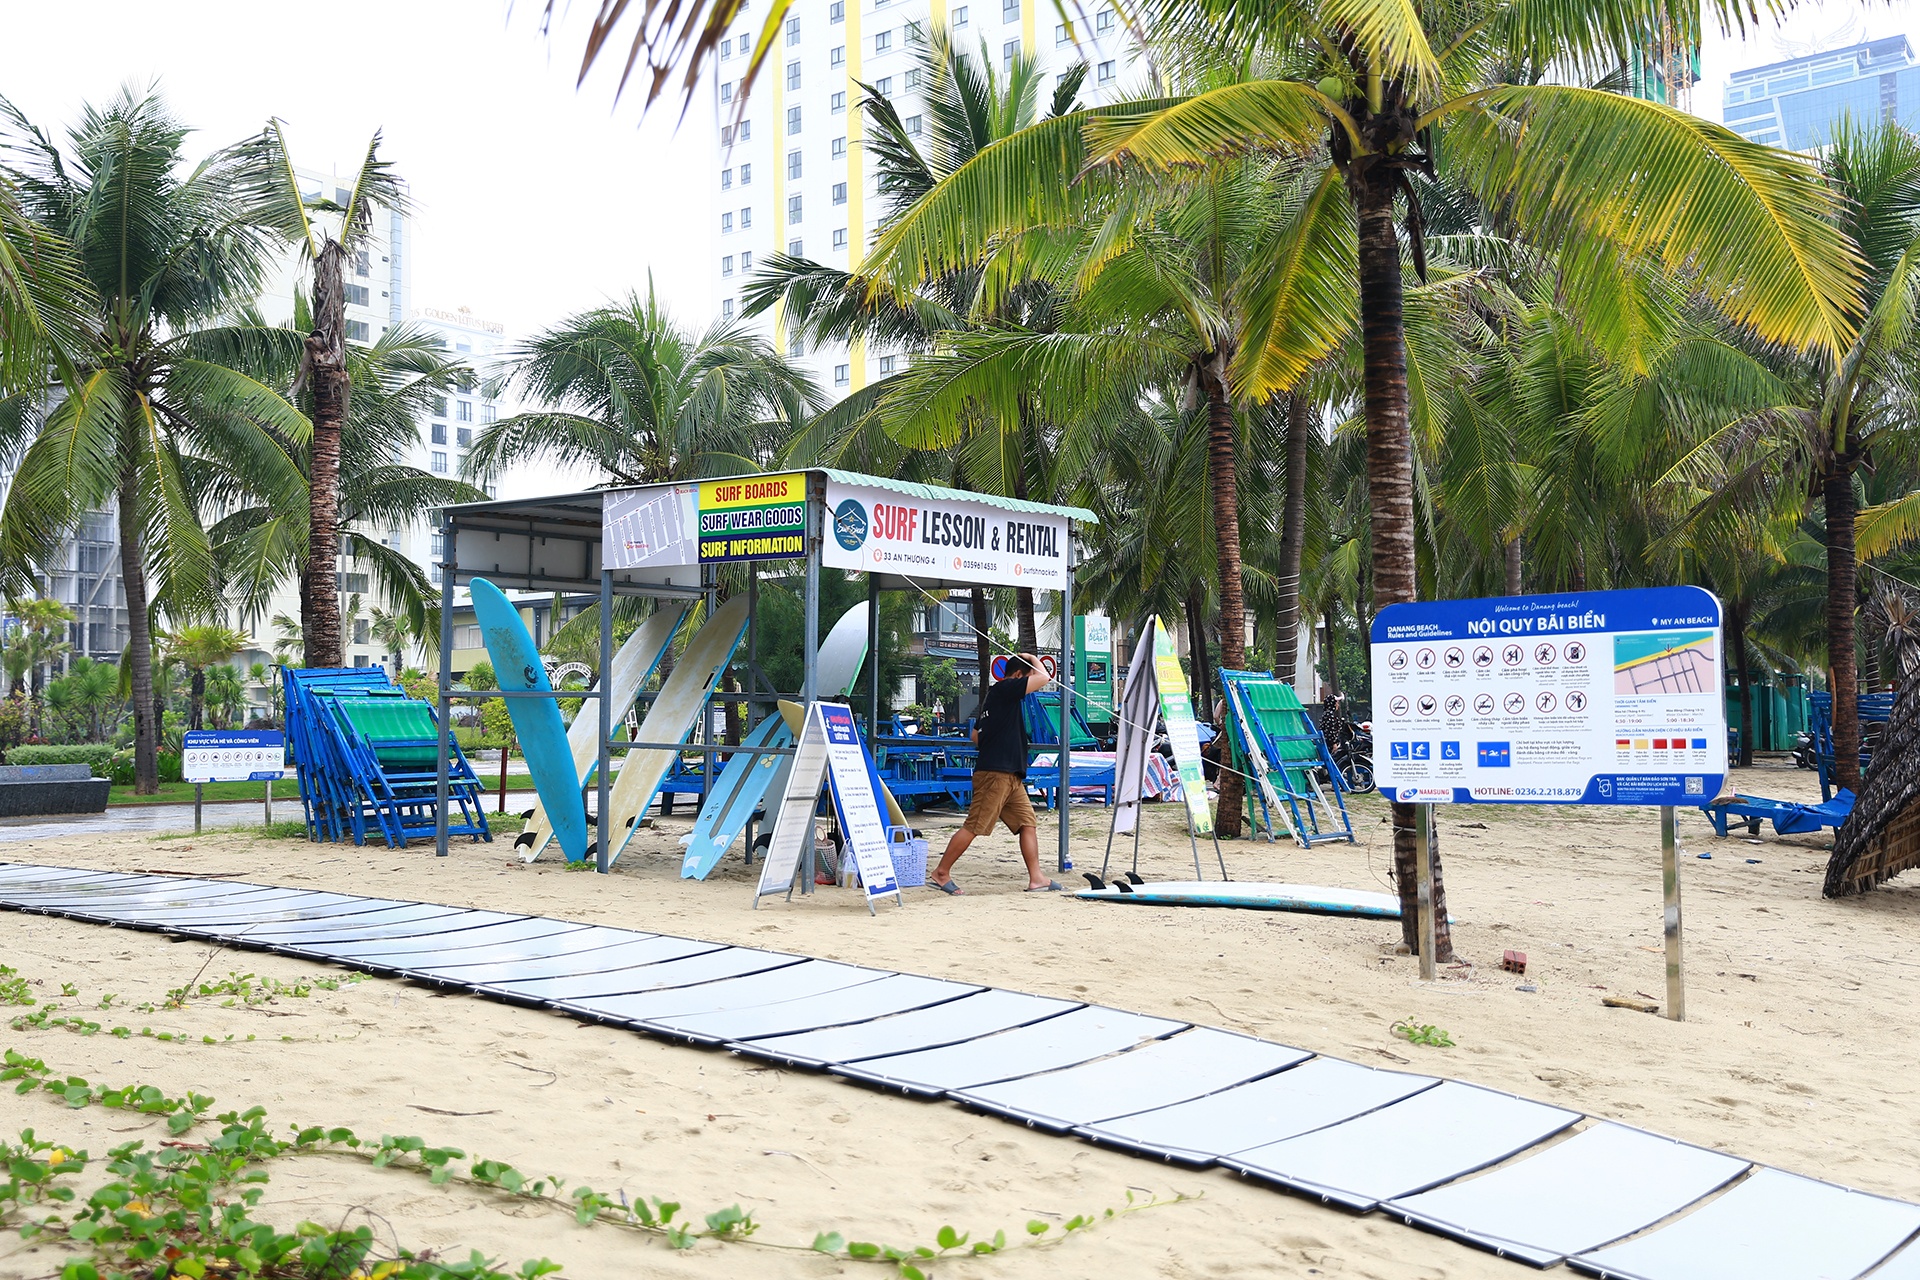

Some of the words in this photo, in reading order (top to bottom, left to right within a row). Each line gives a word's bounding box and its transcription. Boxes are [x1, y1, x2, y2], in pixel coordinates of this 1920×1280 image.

[716, 486, 742, 502] SURF
[745, 480, 788, 500] BOARDS
[702, 514, 728, 531] SURF
[731, 511, 762, 528] WEAR
[765, 507, 802, 526] GOODS
[872, 503, 918, 542] SURF
[922, 510, 985, 550] LESSON
[992, 526, 1000, 551] &
[1006, 521, 1059, 558] RENTAL
[701, 541, 727, 558] SURF
[730, 536, 803, 556] INFORMATION
[884, 552, 892, 561] 33
[893, 553, 902, 561] AN
[963, 560, 997, 571] 0359614535
[1495, 604, 1520, 613] Welcome
[1530, 602, 1555, 611] Danang
[1557, 600, 1580, 609] beach!
[1388, 625, 1416, 633] DANANG
[1468, 618, 1496, 637] NỘI
[1499, 617, 1533, 634] QUY
[1537, 613, 1564, 631] BÃI
[1568, 610, 1605, 630] BIỂN
[1418, 629, 1452, 637] Guidelines
[1474, 787, 1514, 796] HOTLINE:
[1515, 787, 1581, 796] 0236.2.218.878
